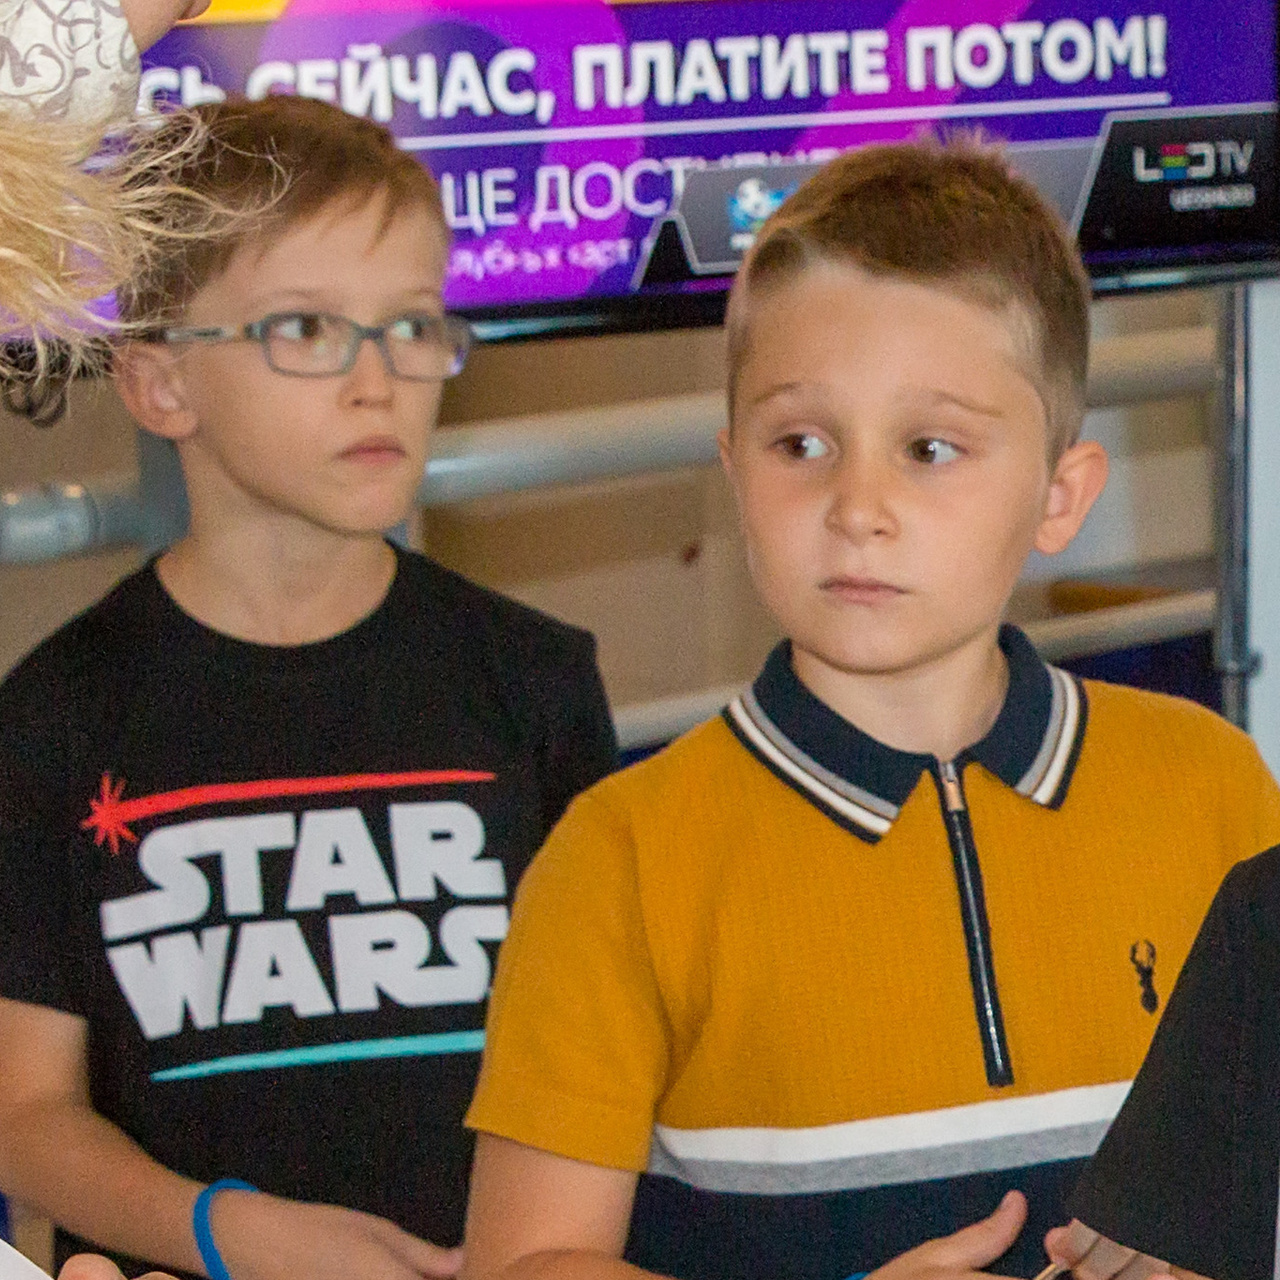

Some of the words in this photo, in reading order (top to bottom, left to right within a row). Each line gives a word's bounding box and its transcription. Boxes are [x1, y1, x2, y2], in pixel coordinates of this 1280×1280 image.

[246, 43, 556, 124] СЕЙЧАС,
[572, 29, 890, 111] ПЛАТИТЕ
[905, 14, 1167, 92] ПОТОМ!
[101, 801, 507, 941] STAR
[105, 904, 511, 1040] WARS
